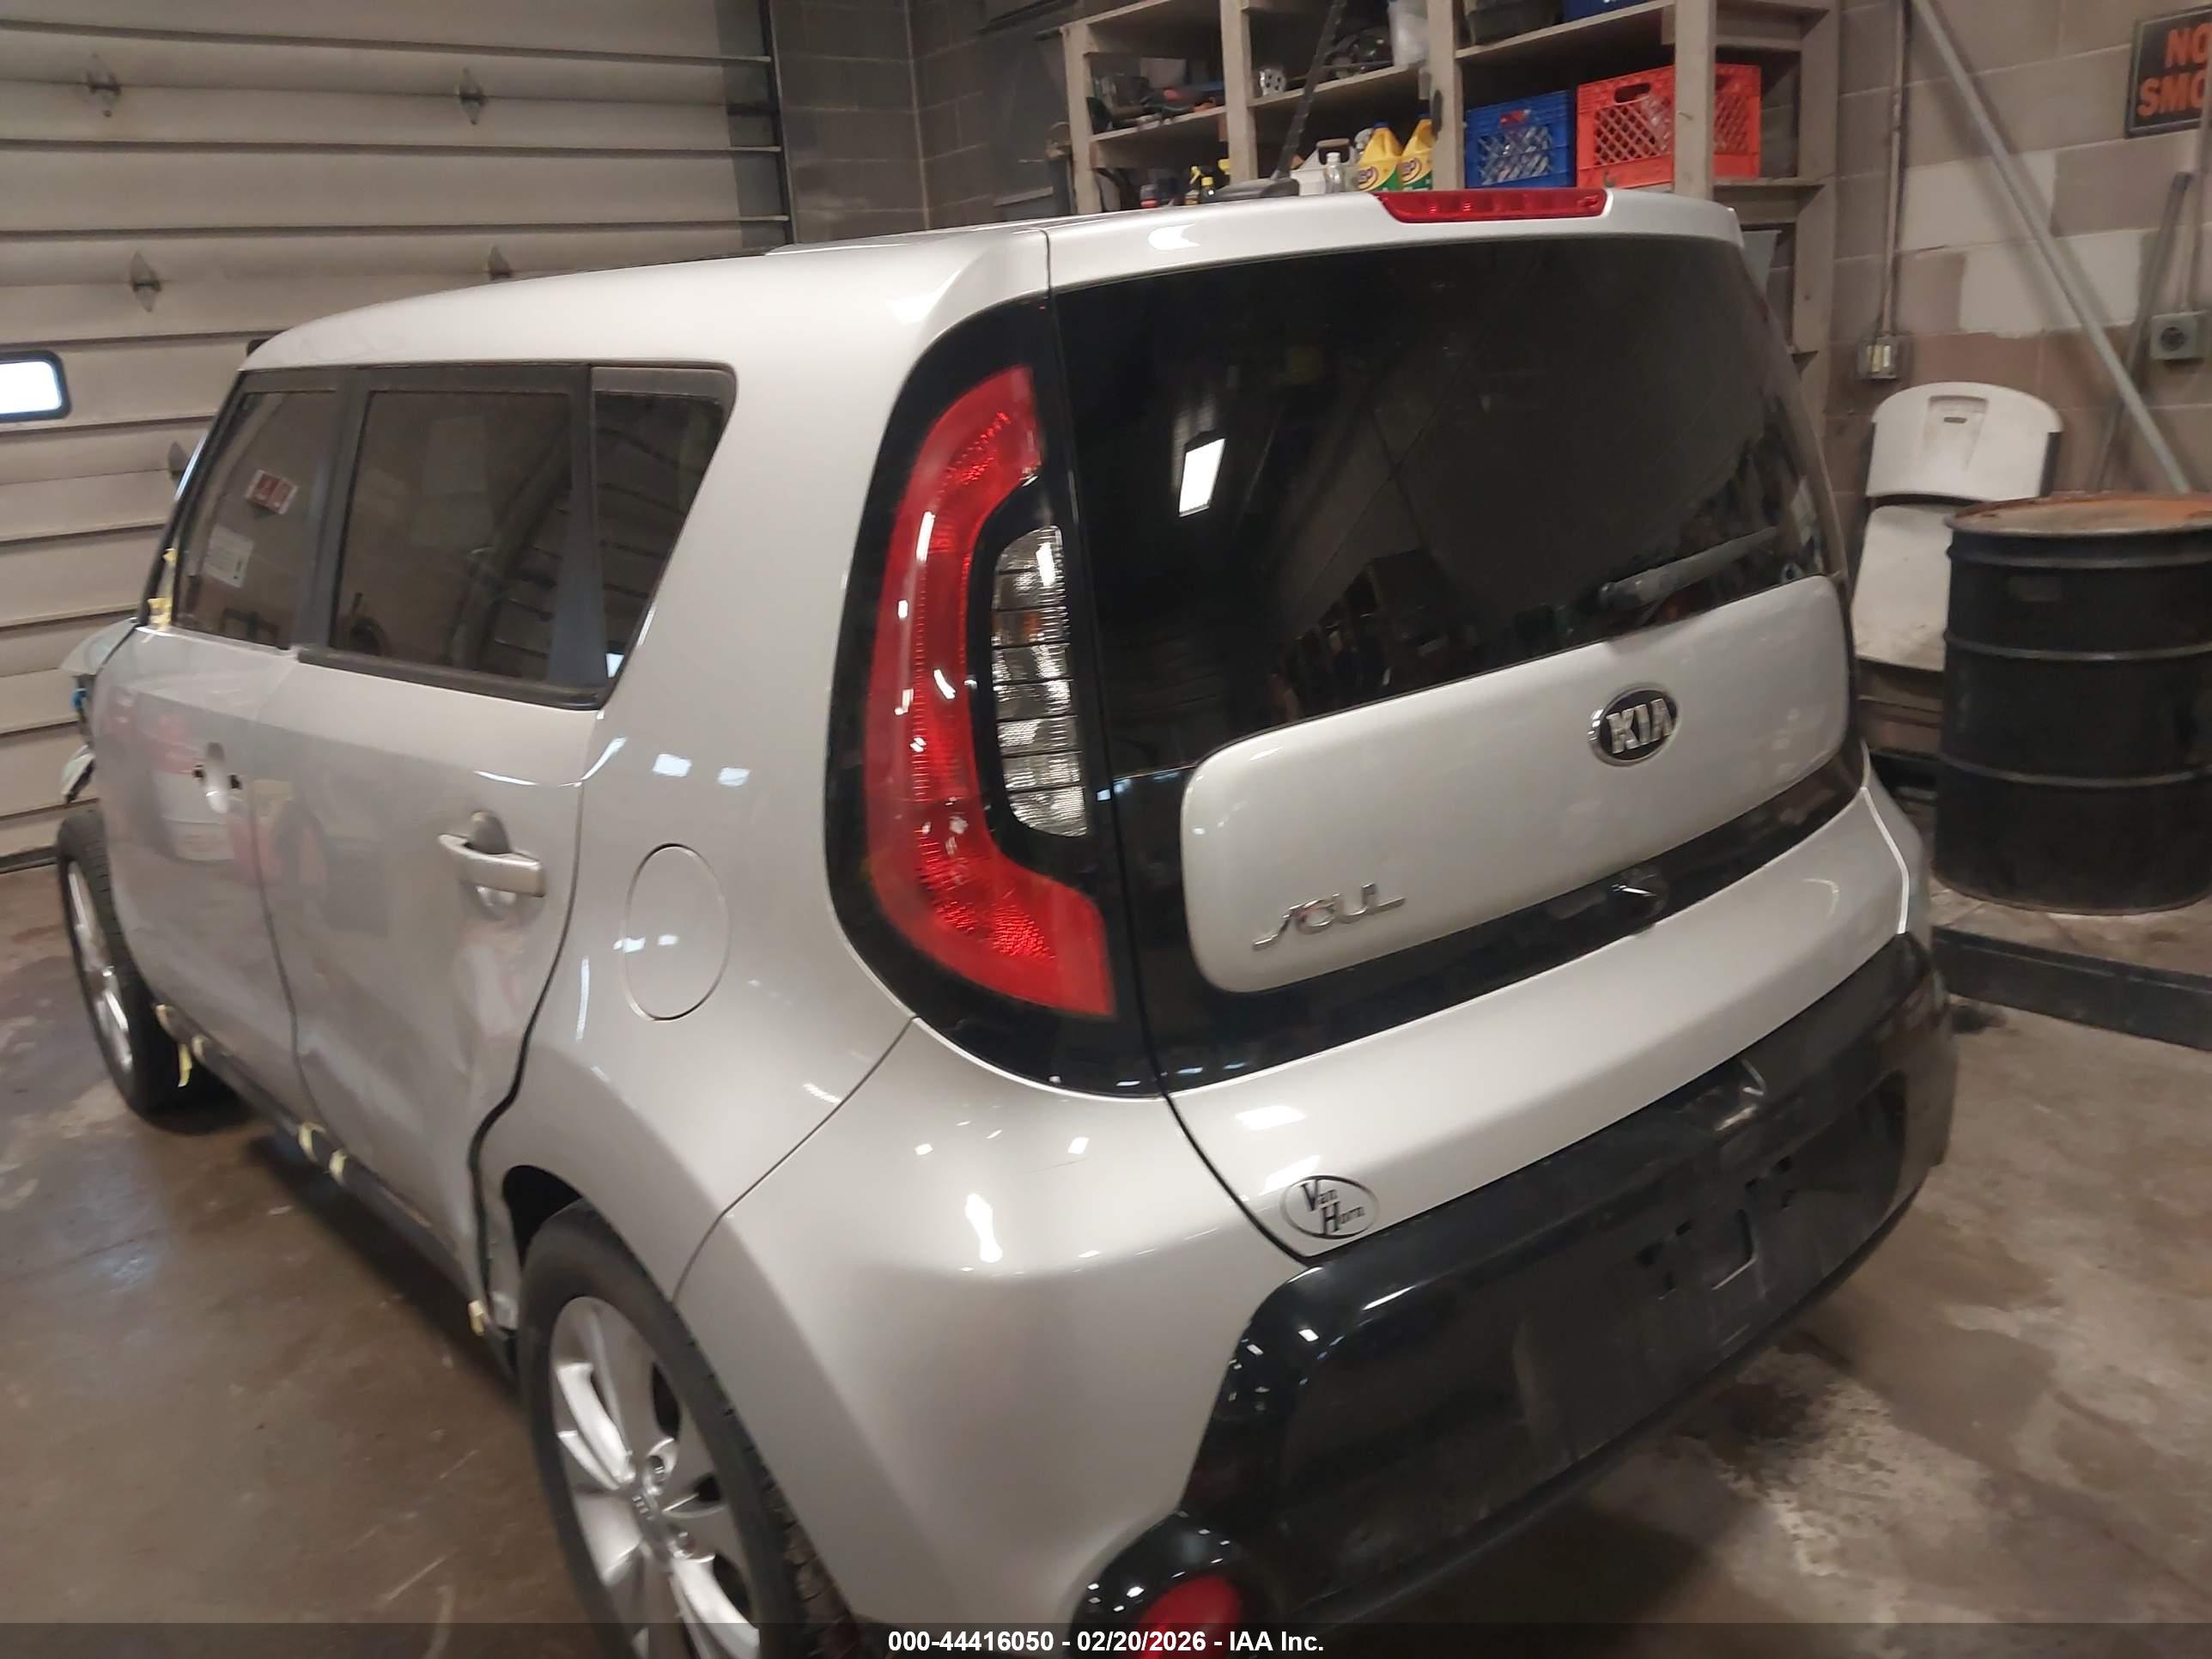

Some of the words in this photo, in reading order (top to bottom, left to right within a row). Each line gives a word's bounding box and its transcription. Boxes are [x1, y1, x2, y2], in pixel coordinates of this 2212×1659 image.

[2165, 23, 2212, 69] NO
[1606, 698, 1674, 754] KIA
[1252, 882, 1406, 951] SOUL
